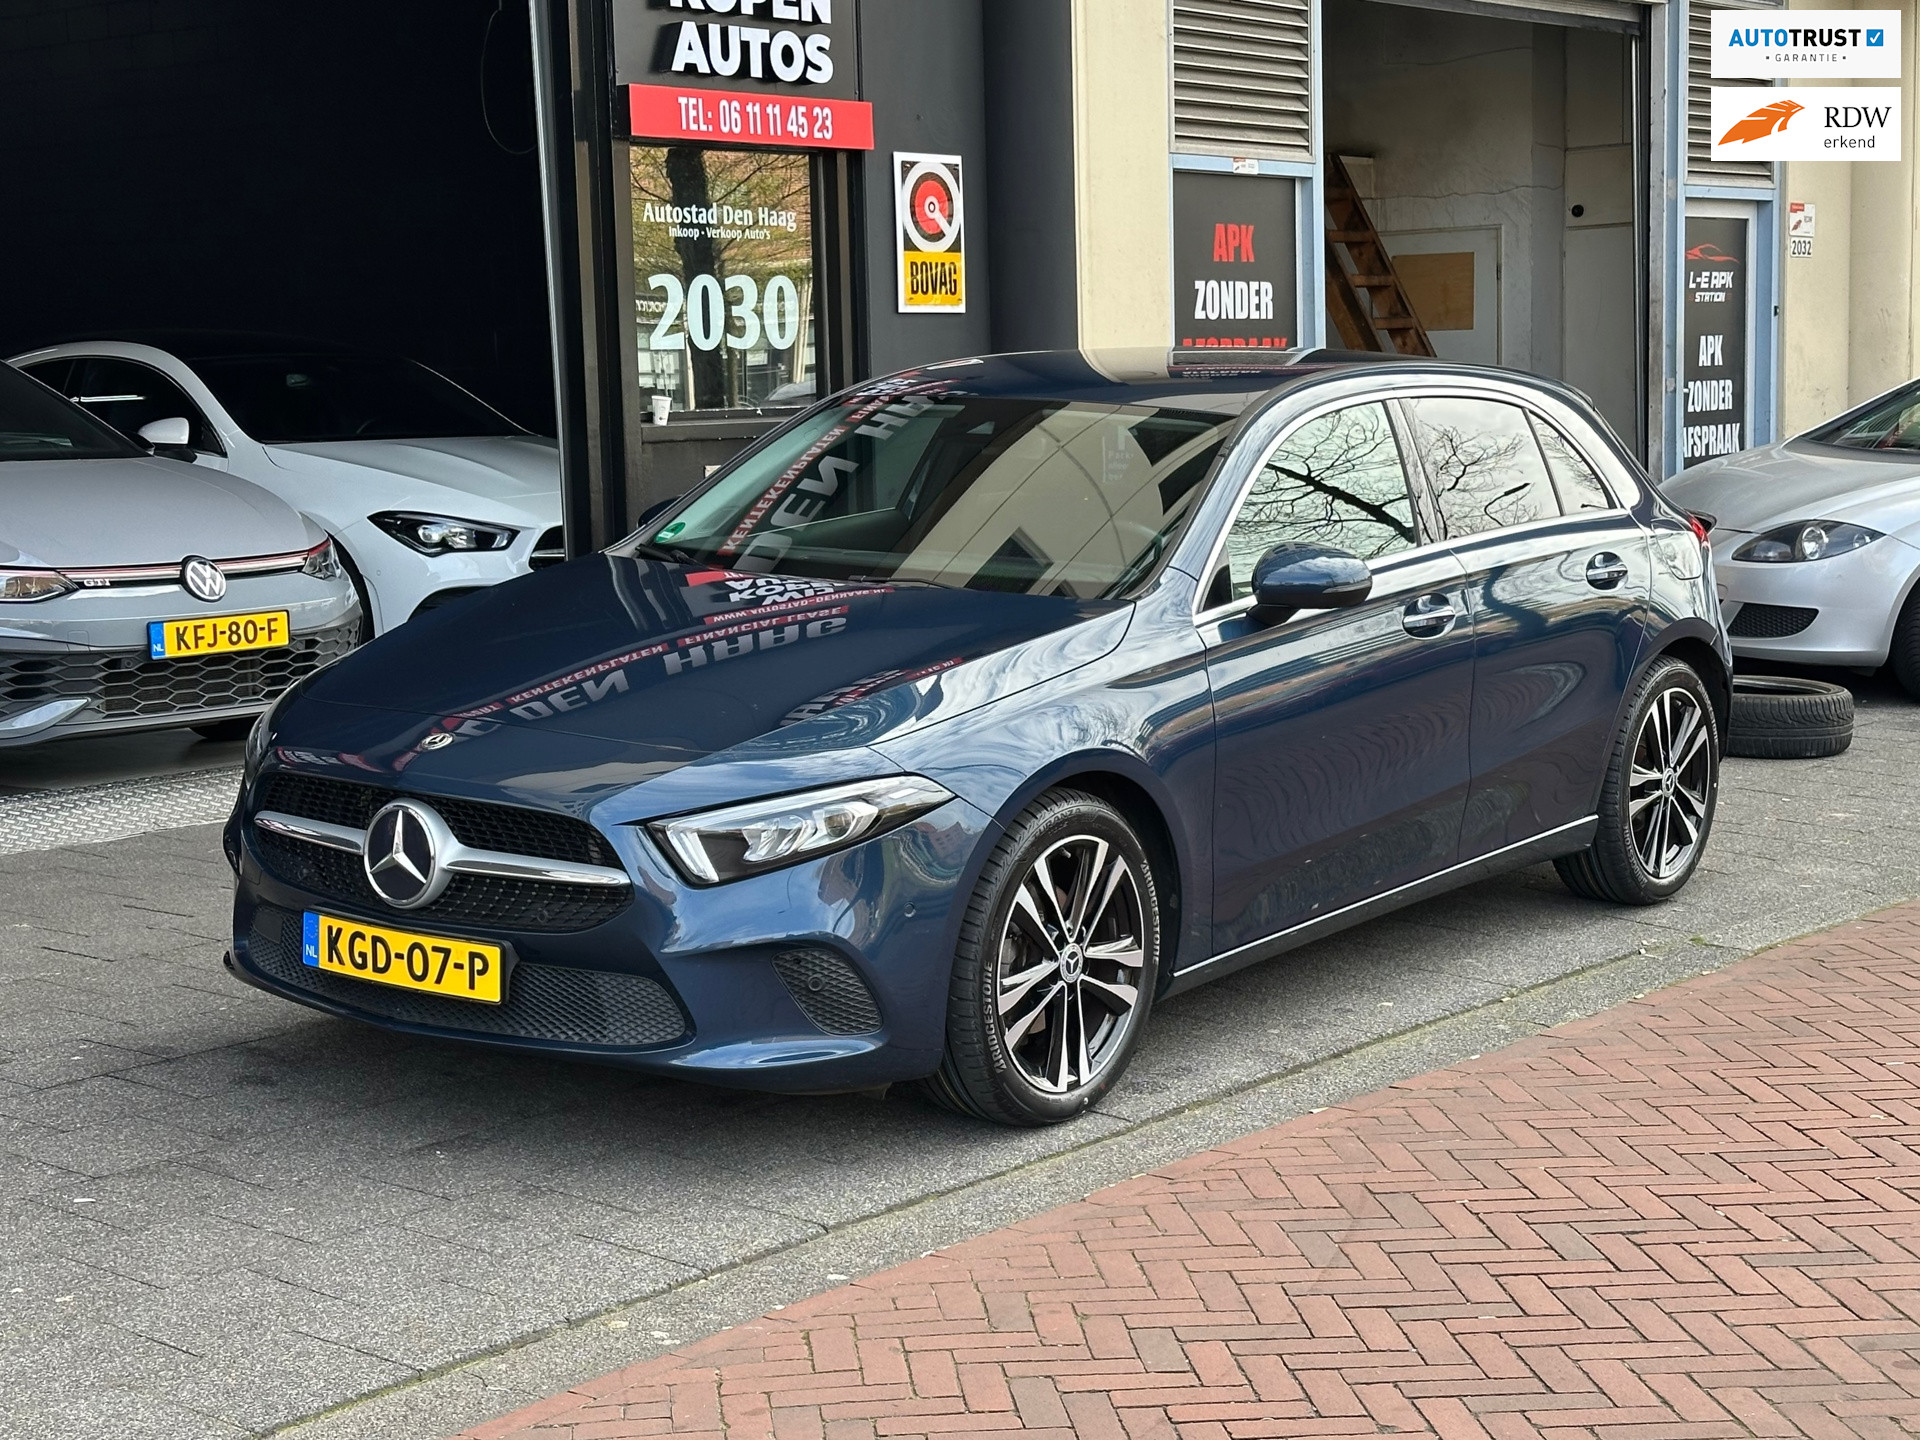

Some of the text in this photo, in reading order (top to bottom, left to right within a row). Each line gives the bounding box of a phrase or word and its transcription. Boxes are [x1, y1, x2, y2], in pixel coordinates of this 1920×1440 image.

[671, 20, 834, 84] AUTOS
[678, 96, 834, 141] TEL: 06 11 11 45 23
[643, 202, 797, 232] Autostad Den Haag
[669, 225, 771, 242] Inkoop Verkoop Auto's
[1213, 222, 1255, 263] APK
[1791, 239, 1812, 256] 2032
[909, 260, 958, 297] BOVAG
[1688, 271, 1734, 289] L-E APK
[648, 273, 800, 352] 2030
[1193, 280, 1274, 320] ZONDER
[1694, 291, 1726, 303] STATION
[1698, 334, 1724, 367] APK
[1687, 379, 1733, 413] ZONDER
[1683, 422, 1741, 458] AFSPRAAK
[83, 577, 111, 587] GTI
[152, 643, 165, 653] NL
[176, 618, 279, 651] KFJ-80-F
[1140, 859, 1161, 965] BRIDGESTONE
[305, 943, 318, 959] NL
[326, 924, 490, 991] KGD-07-P
[982, 960, 1007, 1074] BRIDGESTONE
